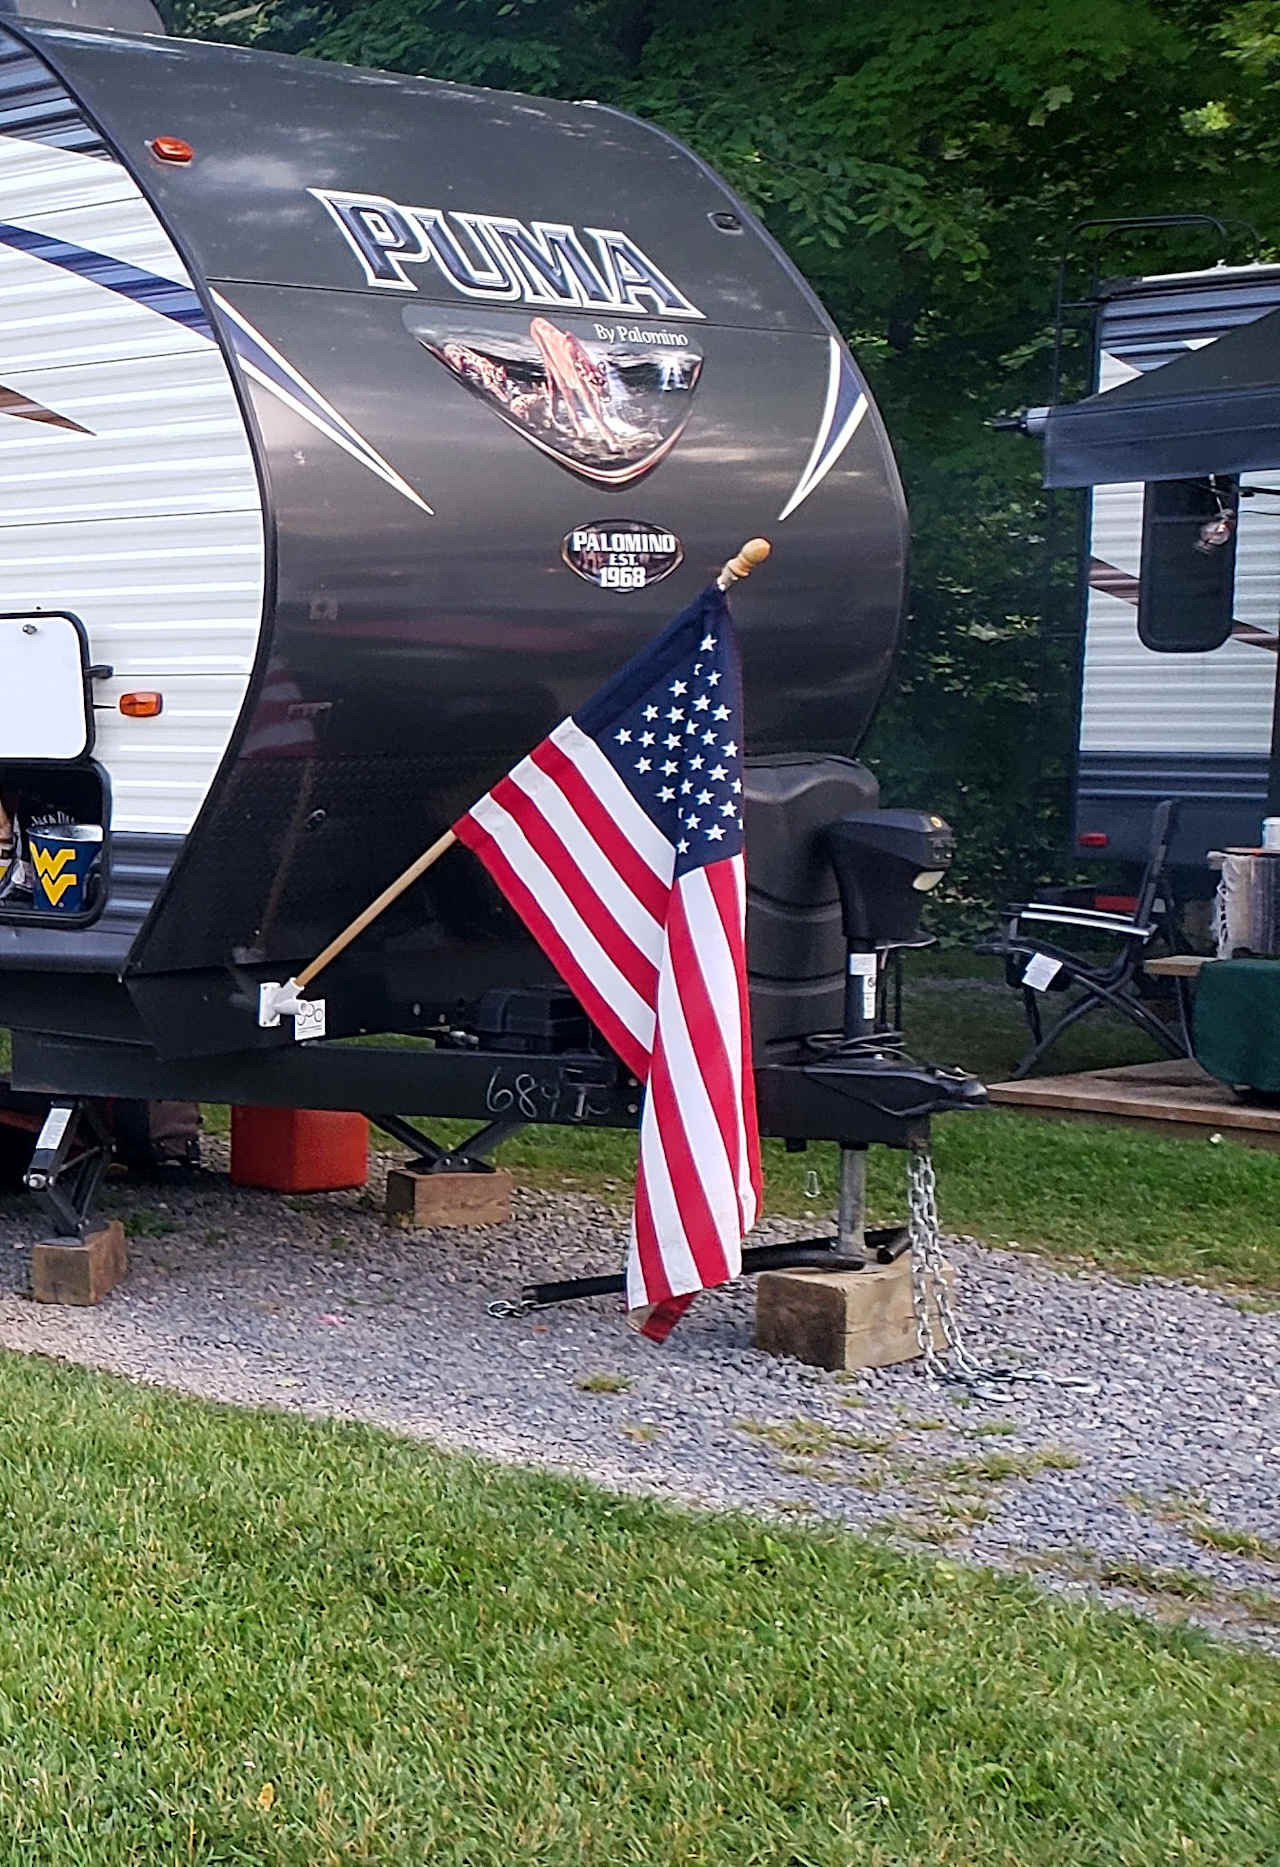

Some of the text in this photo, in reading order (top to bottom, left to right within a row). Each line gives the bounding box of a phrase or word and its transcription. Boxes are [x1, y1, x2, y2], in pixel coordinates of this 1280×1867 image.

[307, 188, 707, 318] PUMA
[593, 323, 689, 347] By Palomino
[572, 531, 676, 553] PALOMINO
[608, 553, 639, 567] EST.
[599, 566, 646, 588] 1968
